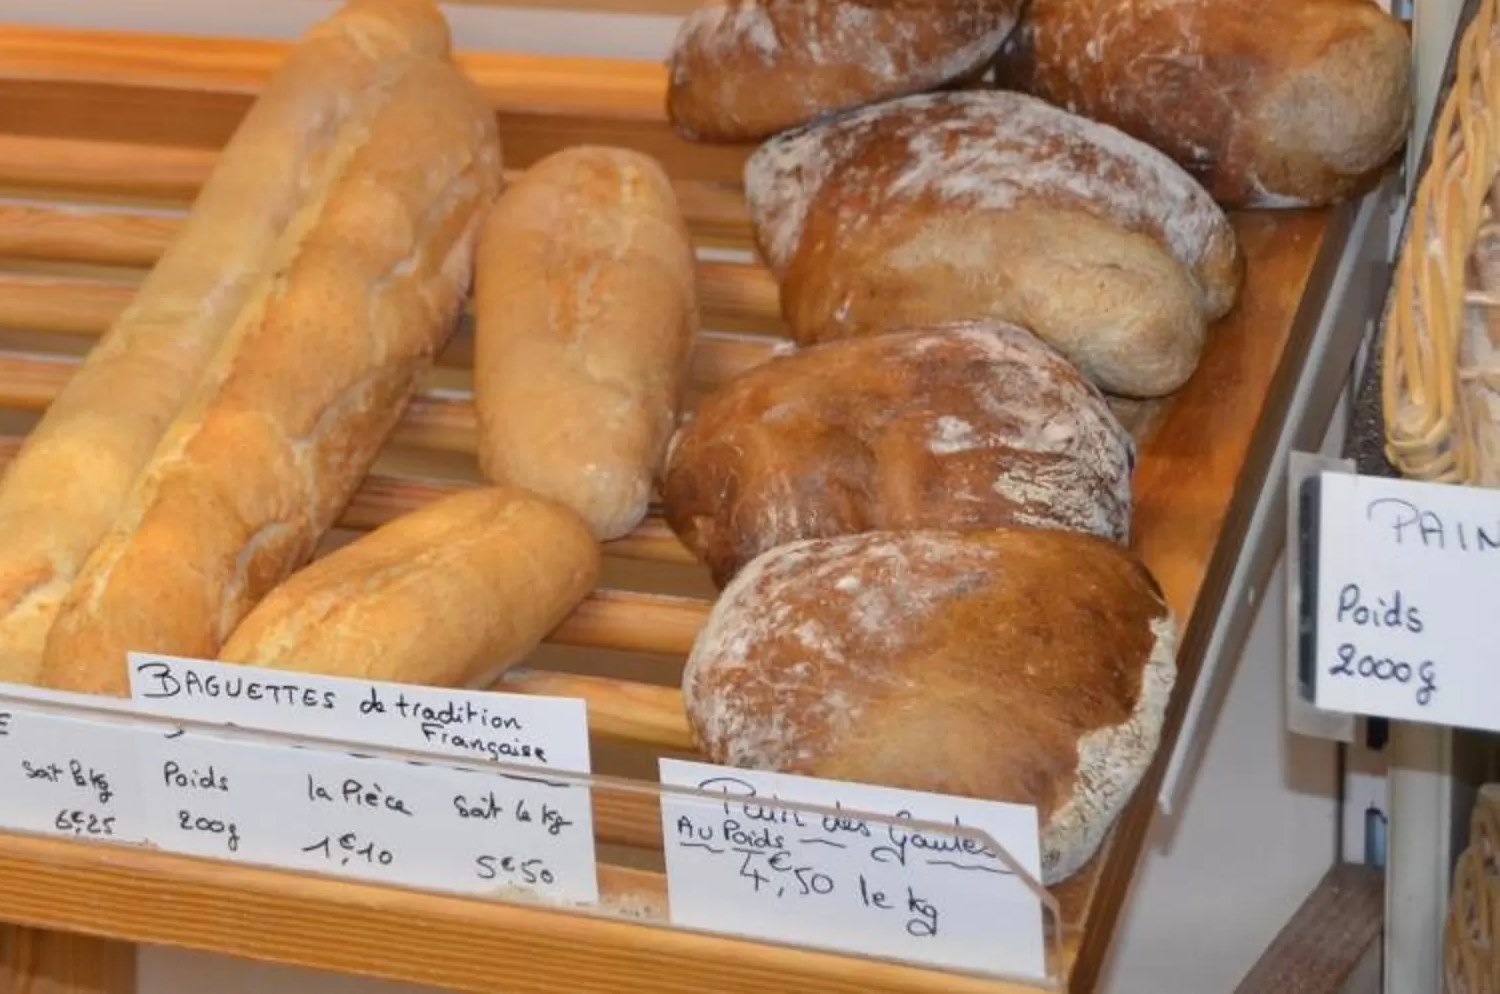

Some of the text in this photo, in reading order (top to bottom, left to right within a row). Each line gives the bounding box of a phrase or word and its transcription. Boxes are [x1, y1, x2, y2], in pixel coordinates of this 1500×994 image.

[1365, 497, 1500, 552] PAIN
[1336, 582, 1425, 634] Poids
[137, 662, 523, 731] BAGUETTES de tradition
[1328, 642, 1438, 706] 2000g
[420, 721, 548, 762] Française
[162, 760, 230, 792] Poids
[307, 773, 334, 802] la
[342, 779, 414, 817] Pièce
[515, 798, 532, 823] le
[697, 776, 807, 828] Pain
[822, 798, 872, 838] des
[178, 809, 241, 852] 200g
[723, 818, 785, 849] Poids
[859, 873, 896, 909] le
